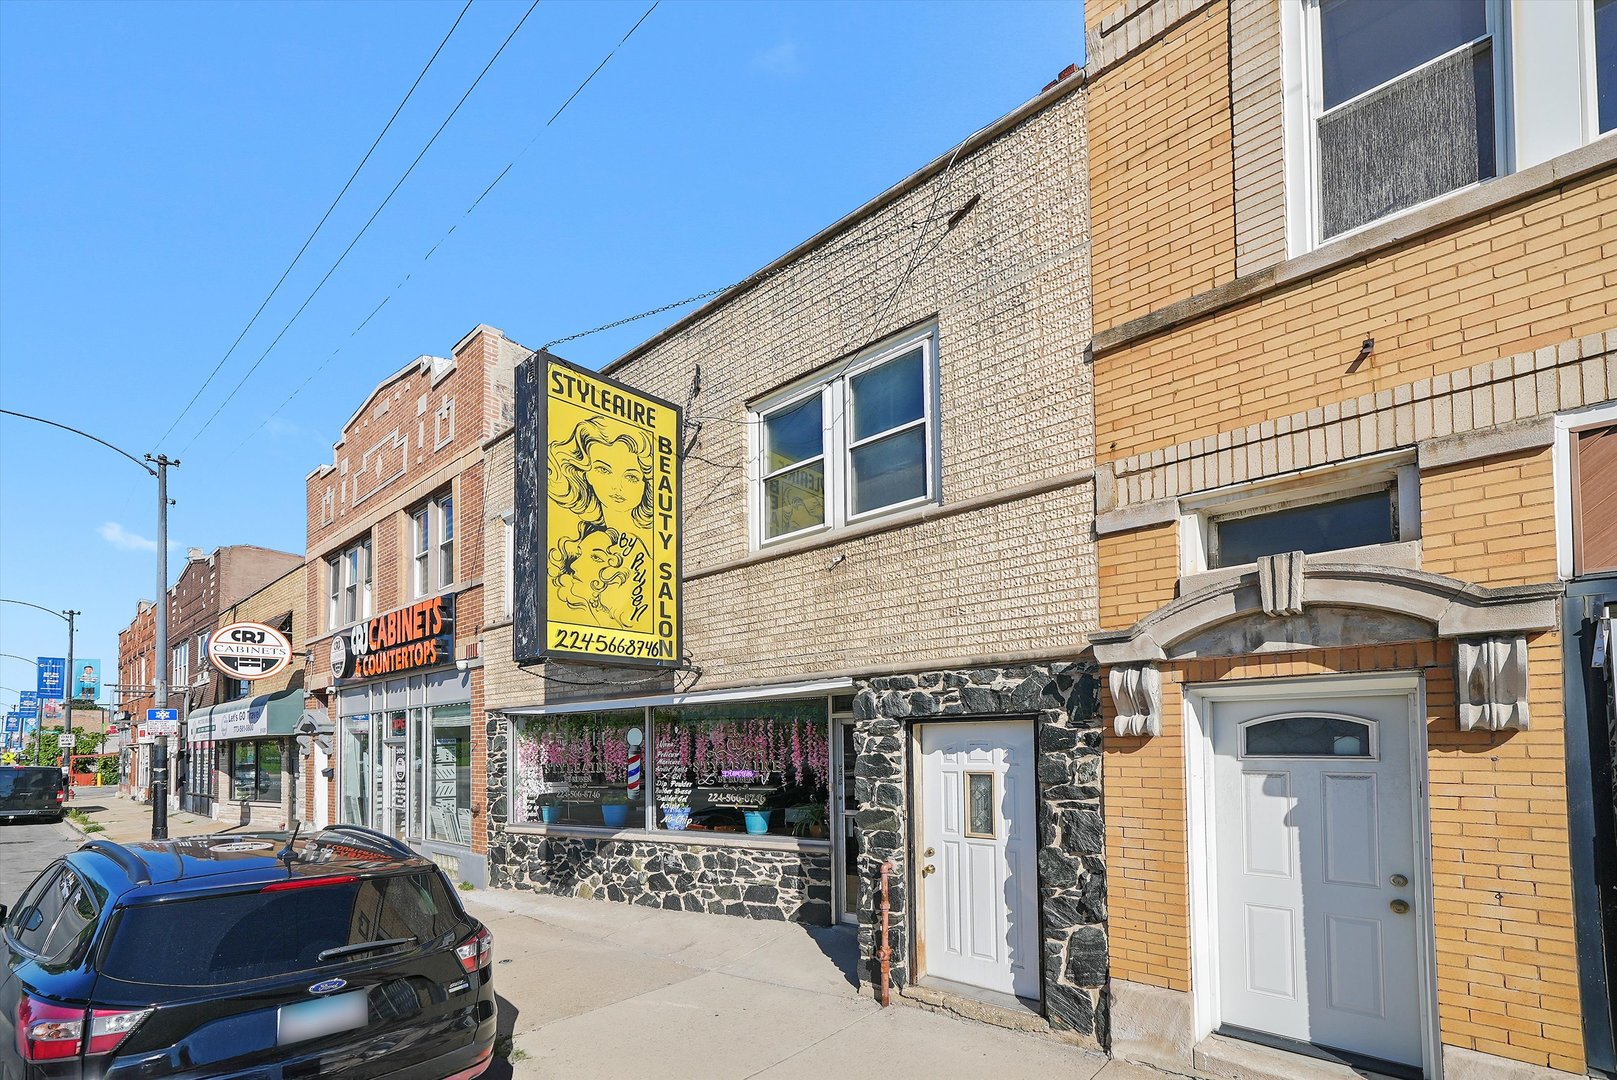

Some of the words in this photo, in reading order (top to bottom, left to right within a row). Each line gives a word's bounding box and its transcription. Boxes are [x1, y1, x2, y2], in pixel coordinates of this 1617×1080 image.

[551, 369, 656, 430] STYLEAIRE
[658, 434, 673, 551] BEAUTY
[618, 532, 638, 557] By
[350, 622, 369, 656] CRJ
[369, 596, 443, 651] CABINETS
[658, 562, 673, 659] SALON
[213, 644, 286, 656] CABINETS
[231, 630, 265, 644] CRJ
[554, 628, 659, 659] 224-566-8746
[355, 657, 362, 678] &
[363, 638, 437, 677] COUNTERTOPS
